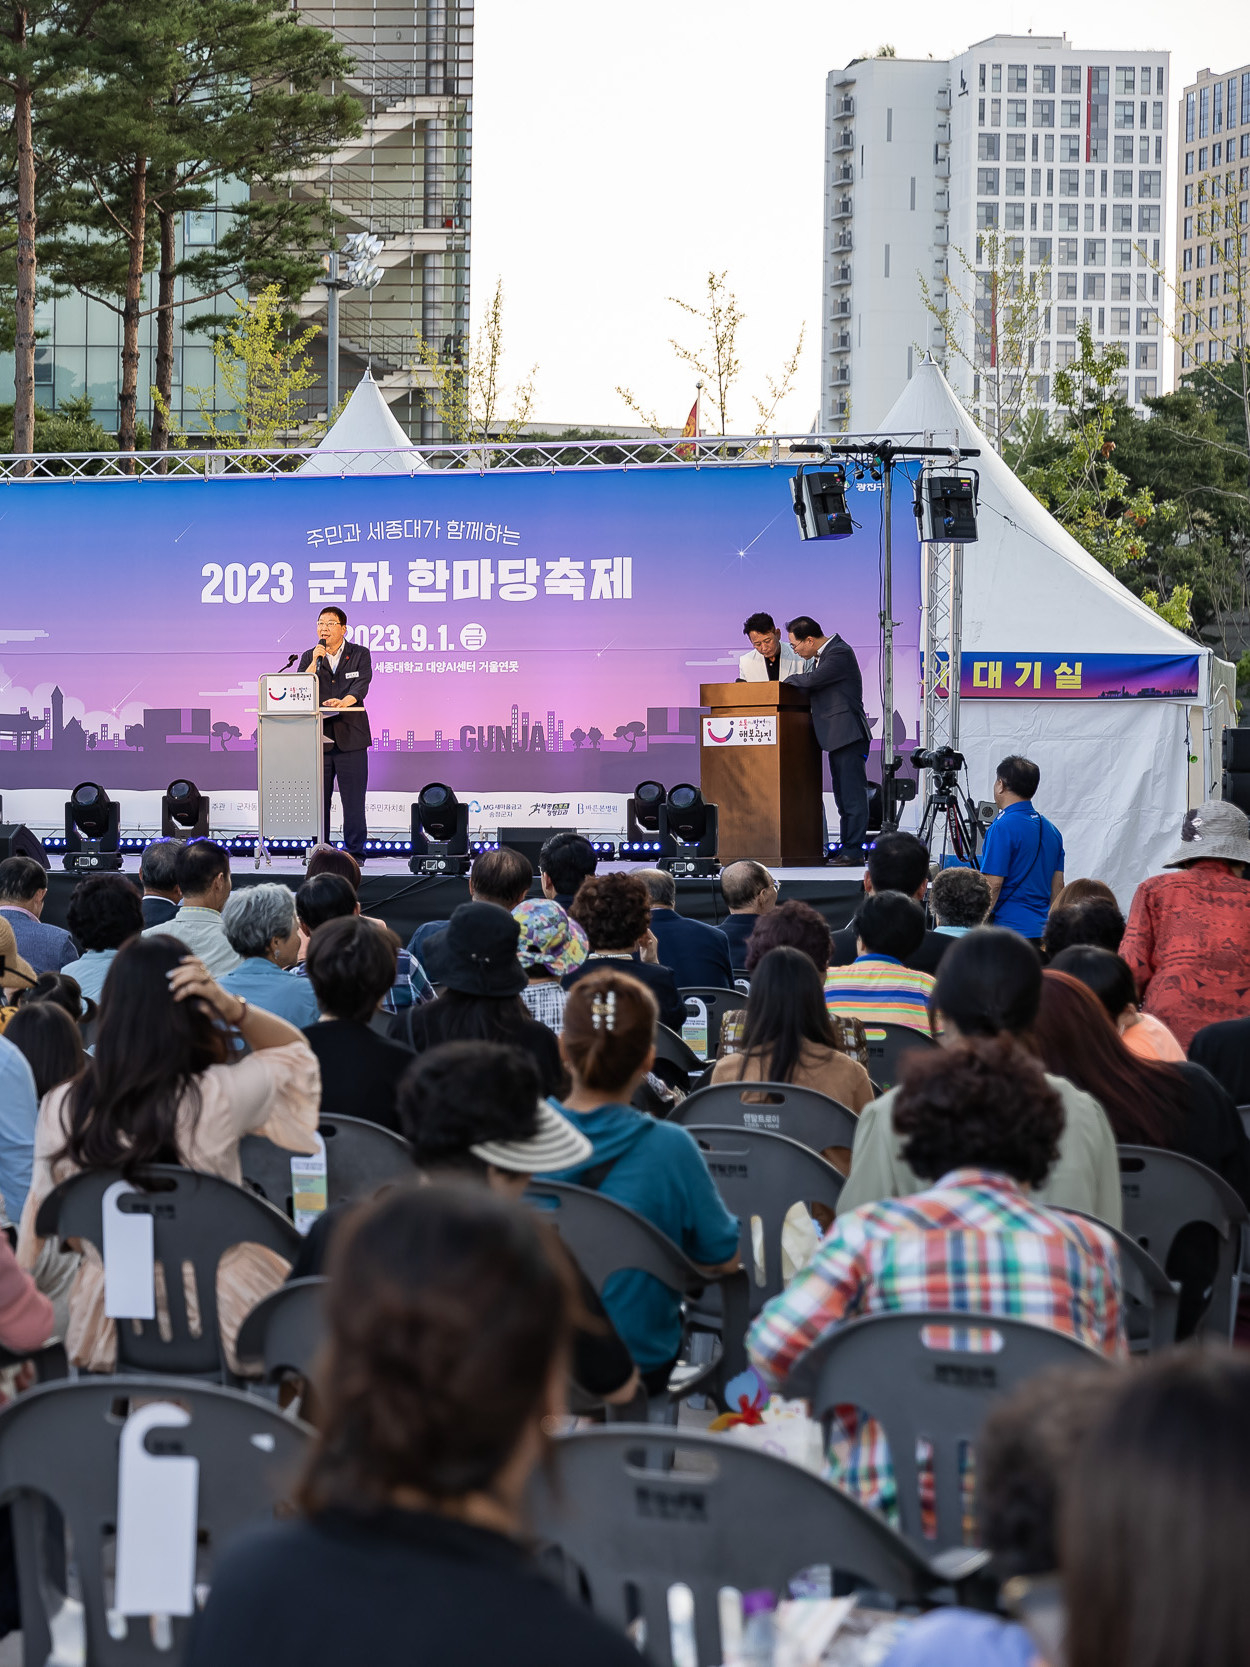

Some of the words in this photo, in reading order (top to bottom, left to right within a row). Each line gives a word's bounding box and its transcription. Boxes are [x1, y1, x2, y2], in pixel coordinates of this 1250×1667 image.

[306, 522, 361, 548] 주민과
[366, 519, 441, 541] 세종대가
[446, 519, 521, 546] 함께하는
[200, 561, 294, 604] 2023
[307, 560, 393, 603] 군자
[407, 556, 633, 603] 한마당축제
[374, 661, 424, 673] 세종대학교
[425, 661, 476, 673] 대양AI센터
[478, 661, 519, 673] 거울연못
[459, 725, 546, 752] GUNJA
[738, 728, 772, 742] 행복광진
[211, 803, 226, 812] 주관
